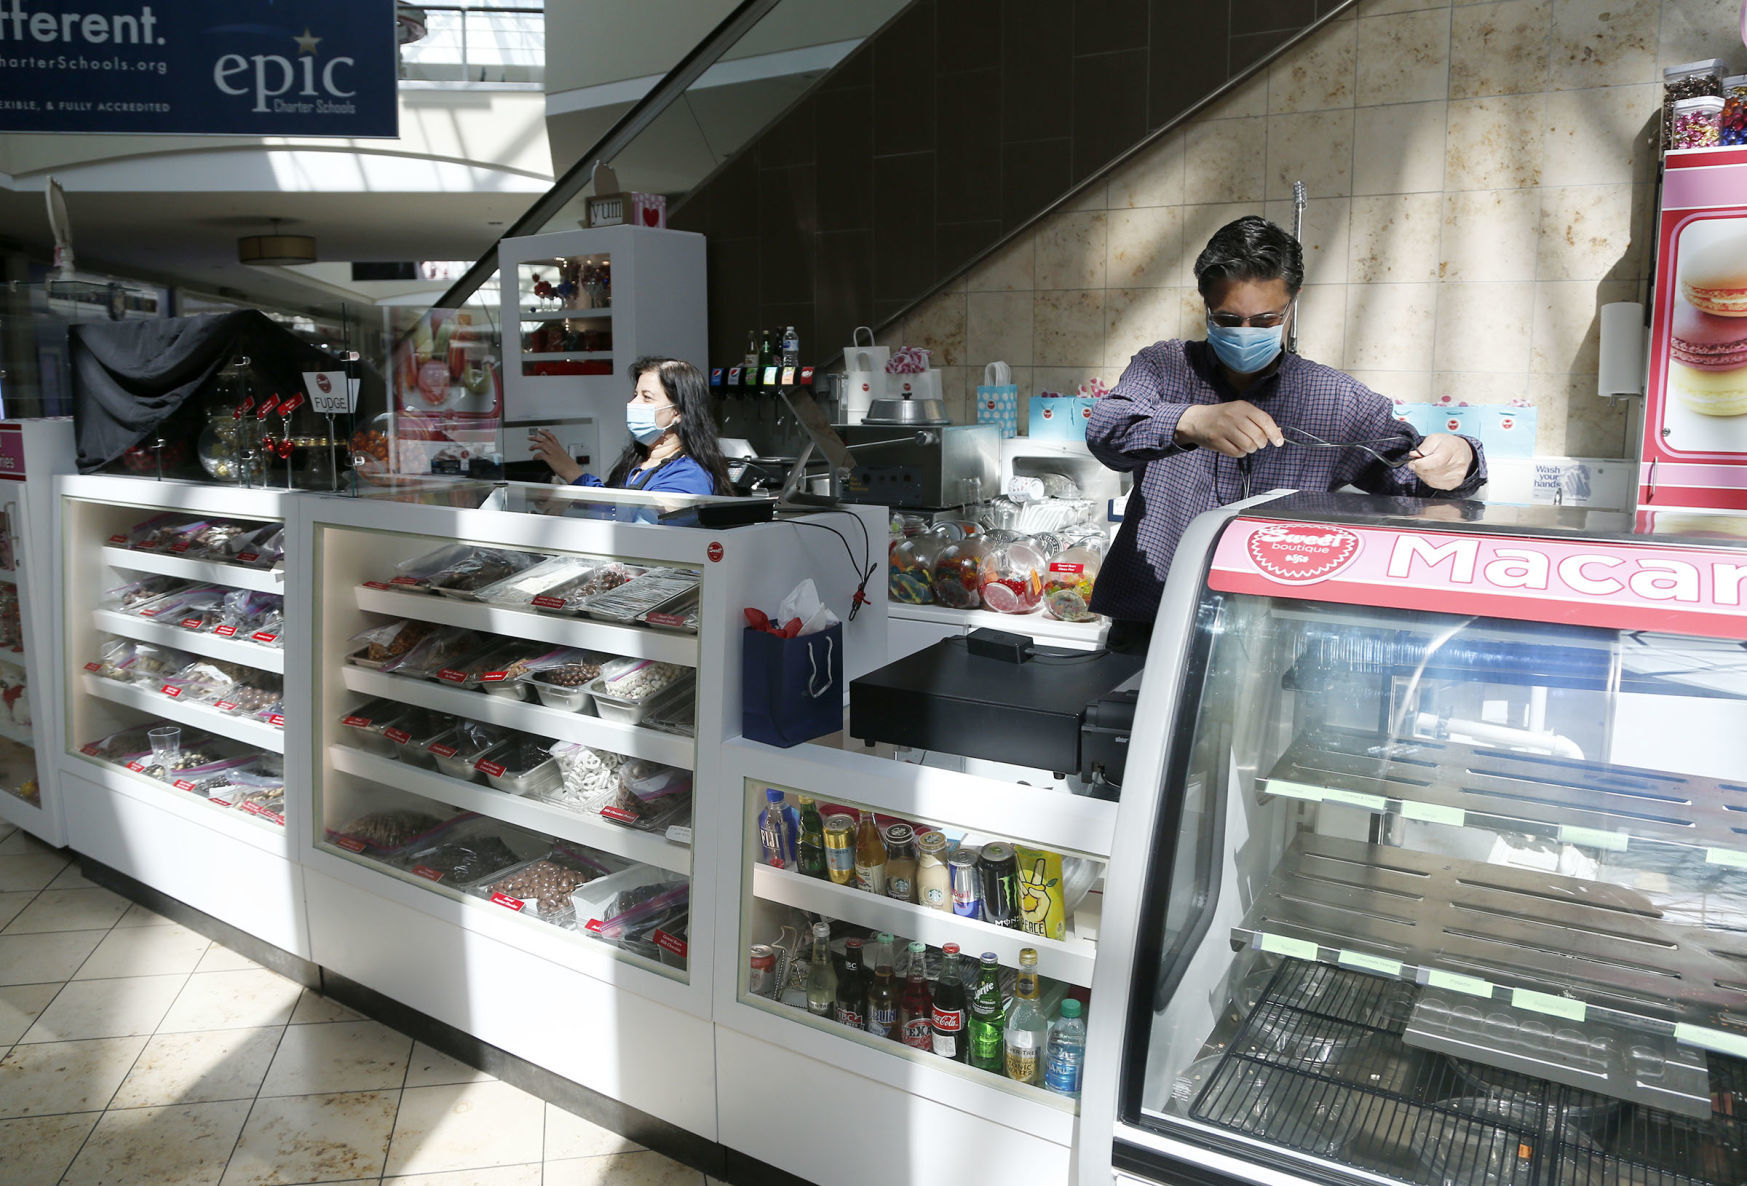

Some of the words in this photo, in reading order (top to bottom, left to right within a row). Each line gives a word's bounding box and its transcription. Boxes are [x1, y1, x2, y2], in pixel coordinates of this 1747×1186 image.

[213, 53, 357, 113] epic
[46, 101, 54, 111] &
[59, 101, 93, 111] FULLY
[97, 102, 171, 112] ACCREDITED
[273, 98, 314, 113] Charter
[316, 99, 356, 114] Schools
[591, 200, 622, 225] yum
[314, 397, 347, 410] FUDGE
[1535, 465, 1561, 473] Wash
[1260, 528, 1350, 547] Sweet
[1272, 543, 1330, 554] boutique
[1387, 535, 1747, 607] Macar
